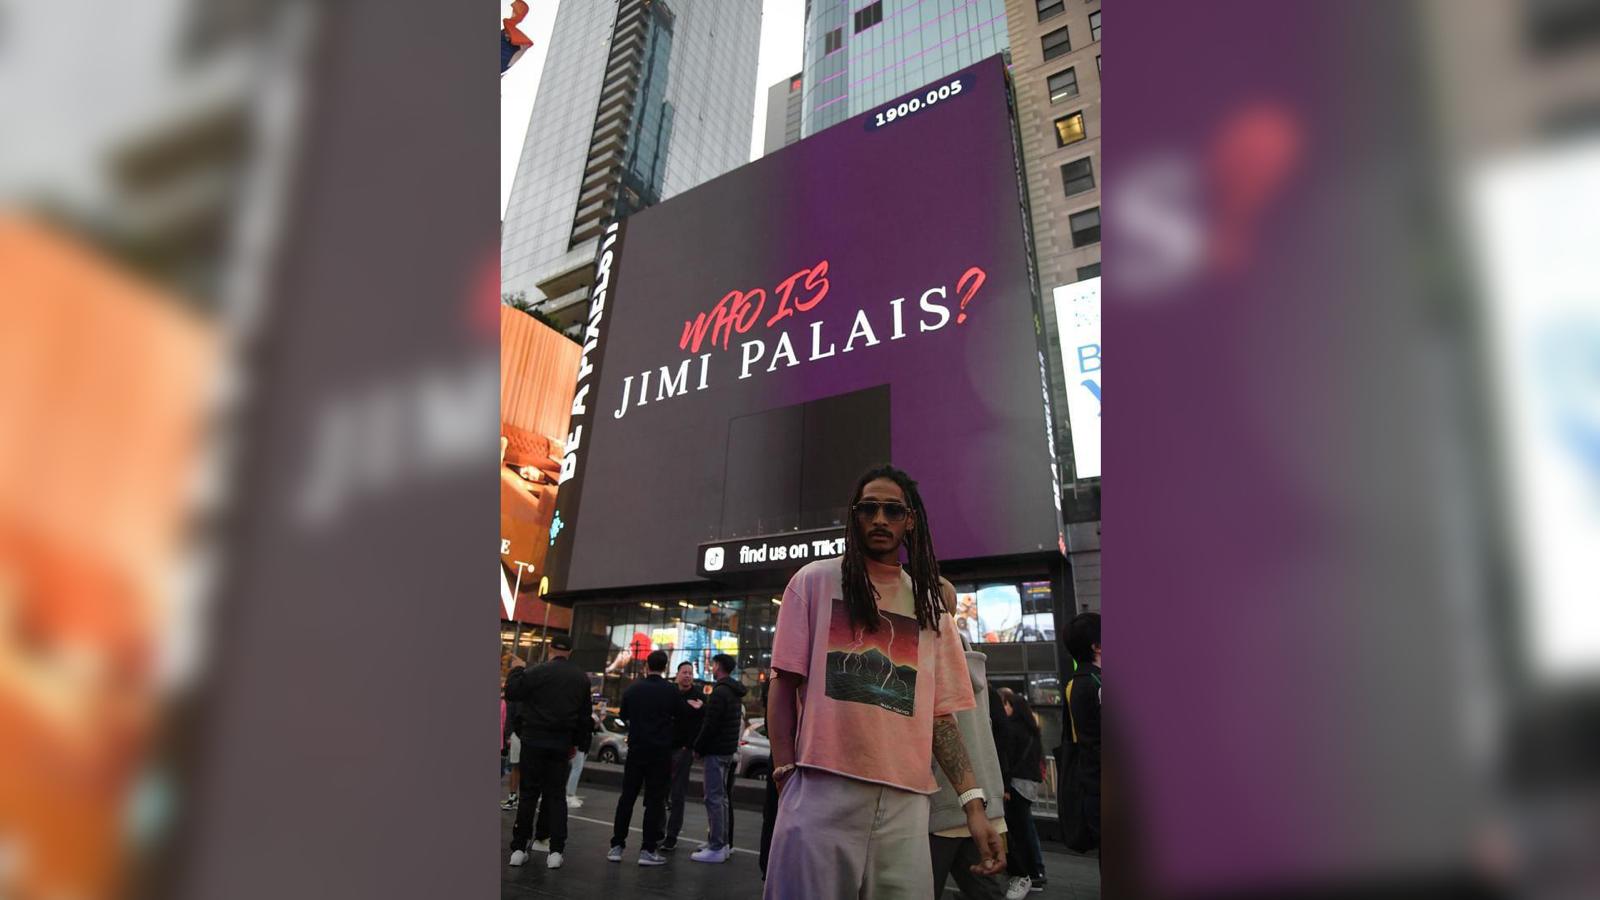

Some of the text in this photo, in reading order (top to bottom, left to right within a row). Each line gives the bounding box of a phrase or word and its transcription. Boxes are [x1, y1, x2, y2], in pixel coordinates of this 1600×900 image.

[876, 79, 964, 127] 1900.005
[679, 260, 830, 353] WHO IS
[613, 353, 712, 419] JIMI
[558, 424, 583, 485] BE
[571, 383, 590, 415] A
[739, 543, 767, 564] find
[769, 545, 788, 561] us
[789, 543, 809, 559] on
